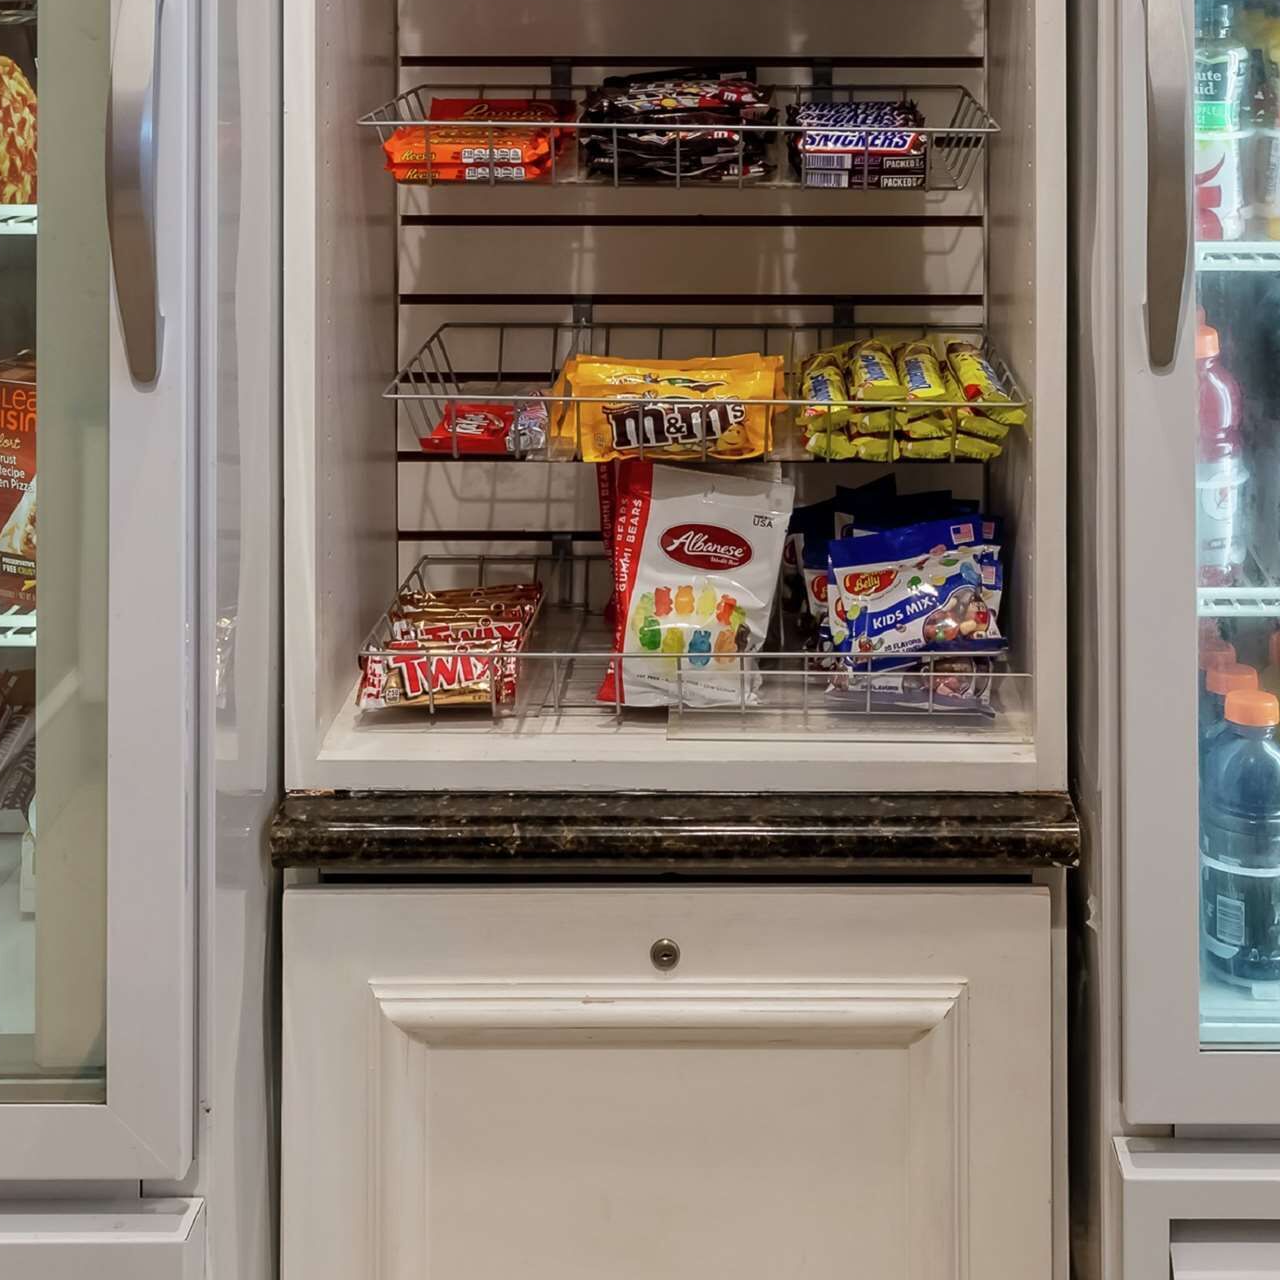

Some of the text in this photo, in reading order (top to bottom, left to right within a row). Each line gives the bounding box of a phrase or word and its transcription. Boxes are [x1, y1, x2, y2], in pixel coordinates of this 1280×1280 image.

[883, 178, 913, 188] PACKED
[2, 387, 37, 411] Lea
[753, 518, 773, 528] USA
[619, 499, 642, 592] GUMMI BEARS
[666, 531, 745, 557] Albanese
[854, 575, 880, 592] Belly
[872, 608, 904, 629] KIDS
